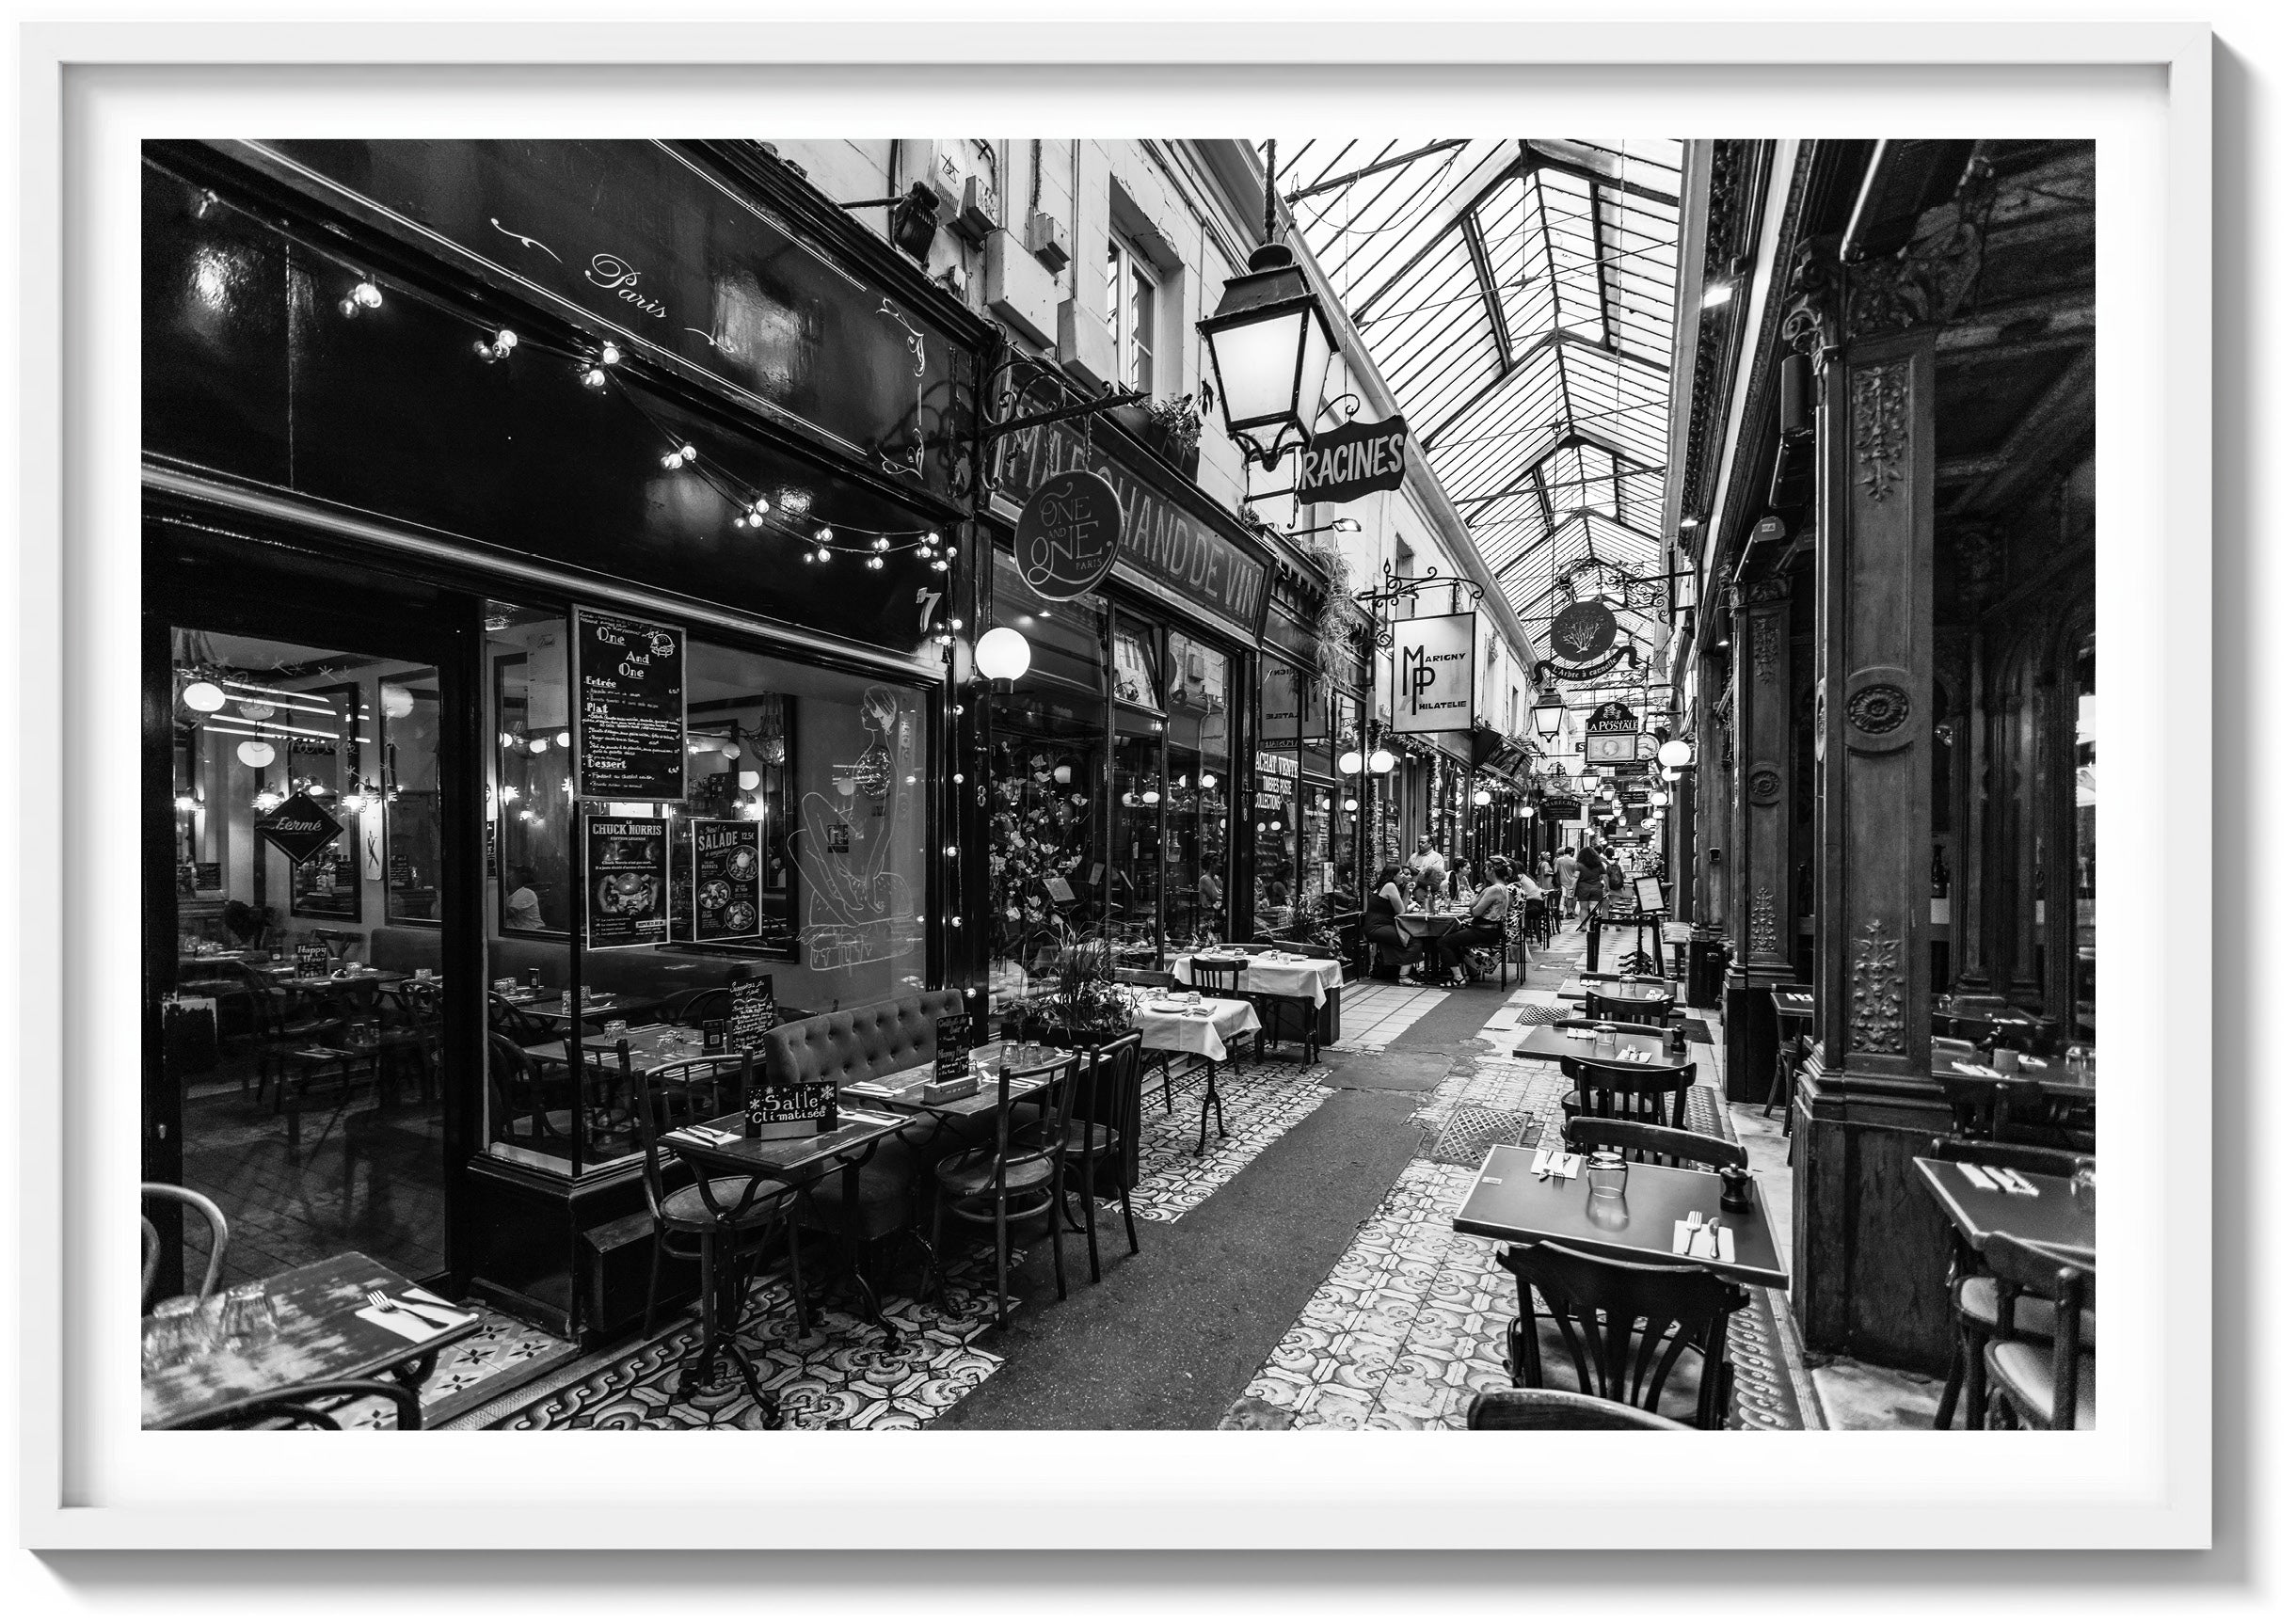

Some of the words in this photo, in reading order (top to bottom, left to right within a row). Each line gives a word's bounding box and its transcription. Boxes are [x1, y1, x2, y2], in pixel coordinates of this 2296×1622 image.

[584, 253, 667, 318] Paris
[1301, 433, 1404, 490] RACINES
[1039, 482, 1092, 527] ONE
[1028, 520, 1113, 584] ONE
[1076, 558, 1103, 570] PARIS
[1189, 533, 1224, 597] DE
[1226, 555, 1260, 619] VIN
[916, 587, 942, 632] 7
[597, 627, 625, 644] One
[626, 651, 650, 663] And
[618, 662, 645, 676] One
[1589, 657, 1617, 676] cannelle
[585, 676, 616, 688] Entrée
[587, 703, 608, 713] Plat
[1586, 722, 1597, 731] LA
[1599, 721, 1638, 731] POSTALE
[587, 758, 627, 769] Dessert
[1255, 751, 1277, 773] ACHAT
[1278, 756, 1299, 779] VENTE
[1280, 778, 1292, 796] POSTE
[977, 785, 986, 807] 8
[275, 817, 323, 831] Fermé
[593, 824, 627, 835] CHUCK
[629, 825, 662, 835] NORRIS
[698, 831, 738, 851] SALADE
[297, 946, 327, 957] Happy
[764, 1091, 819, 1111] Salle
[752, 1108, 825, 1123] Climatisée
